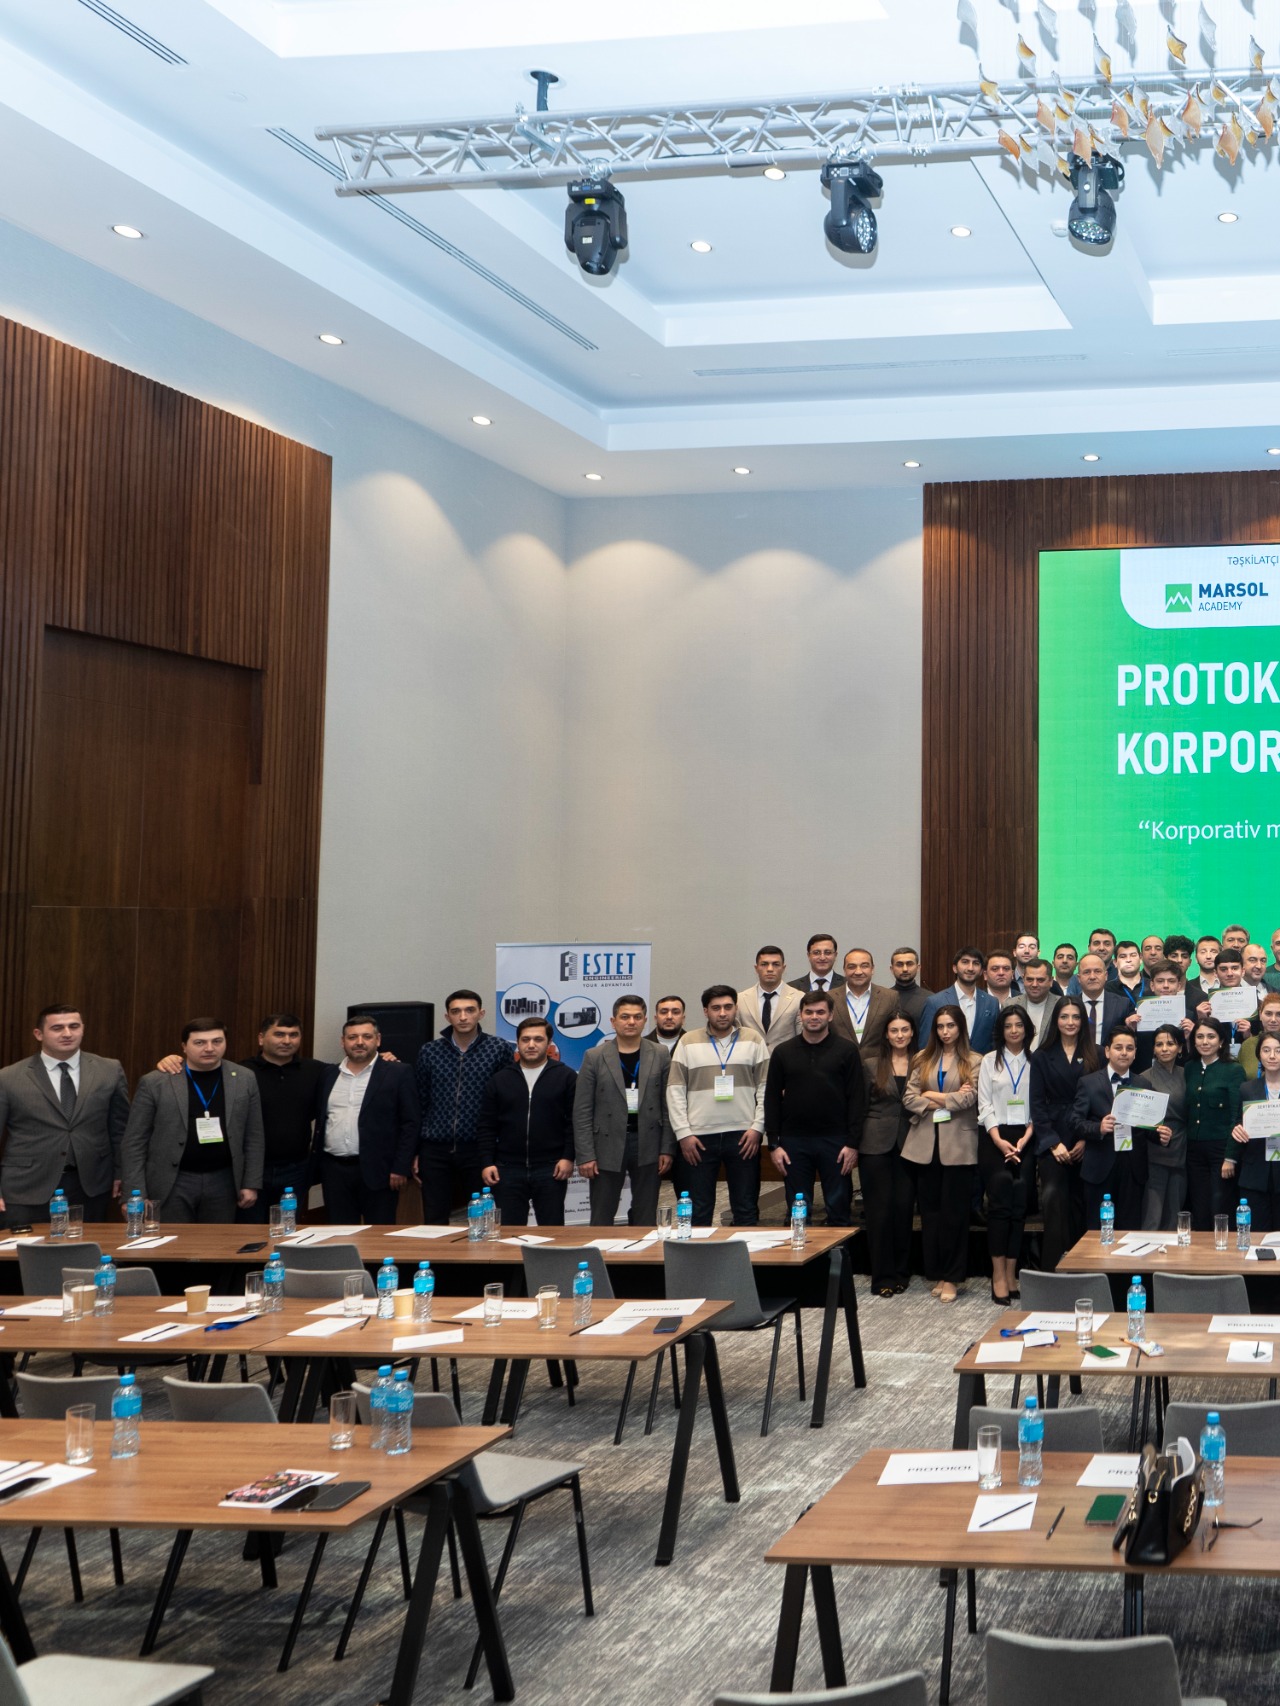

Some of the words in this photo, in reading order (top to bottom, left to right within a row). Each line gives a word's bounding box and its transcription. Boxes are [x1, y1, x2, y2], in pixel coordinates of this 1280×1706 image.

[1198, 582, 1269, 598] MARSOL
[1198, 601, 1243, 612] ACADEMY
[583, 953, 636, 975] ESTET
